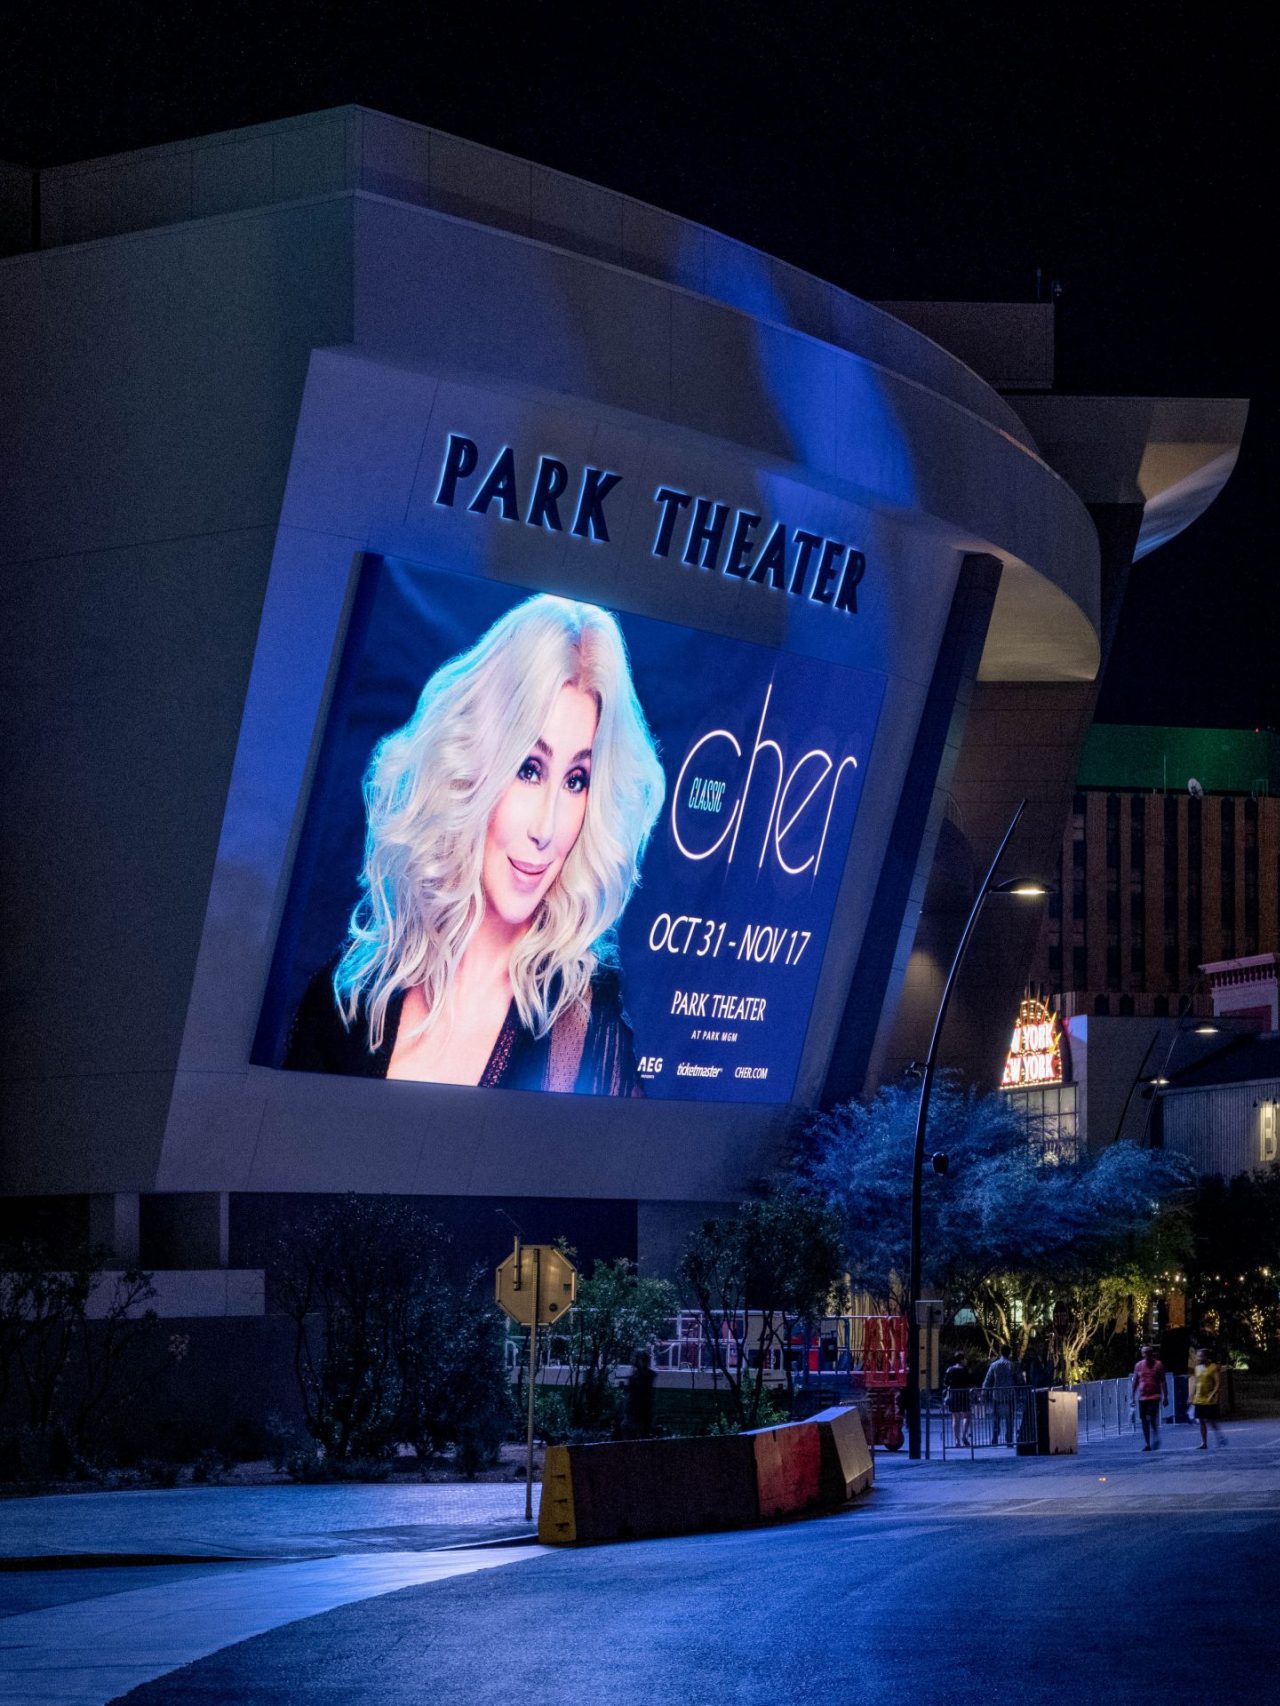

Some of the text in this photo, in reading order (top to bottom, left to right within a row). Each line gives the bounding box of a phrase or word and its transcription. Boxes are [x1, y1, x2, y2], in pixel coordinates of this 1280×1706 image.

[434, 432, 868, 615] PARK THEATER
[687, 776, 727, 814] CLASSIC
[649, 913, 702, 954] OCT
[696, 920, 727, 957] 31
[737, 924, 787, 964] NOV
[785, 930, 812, 966] 17
[670, 990, 767, 1022] PARK THEATER
[691, 1030, 738, 1042] AT PARK MGM
[1022, 1023, 1056, 1052] YORK
[637, 1056, 663, 1073] AEG
[676, 1062, 722, 1078] ticketmaster
[734, 1066, 768, 1079] CHER.COM
[1022, 1053, 1056, 1082] YORK
